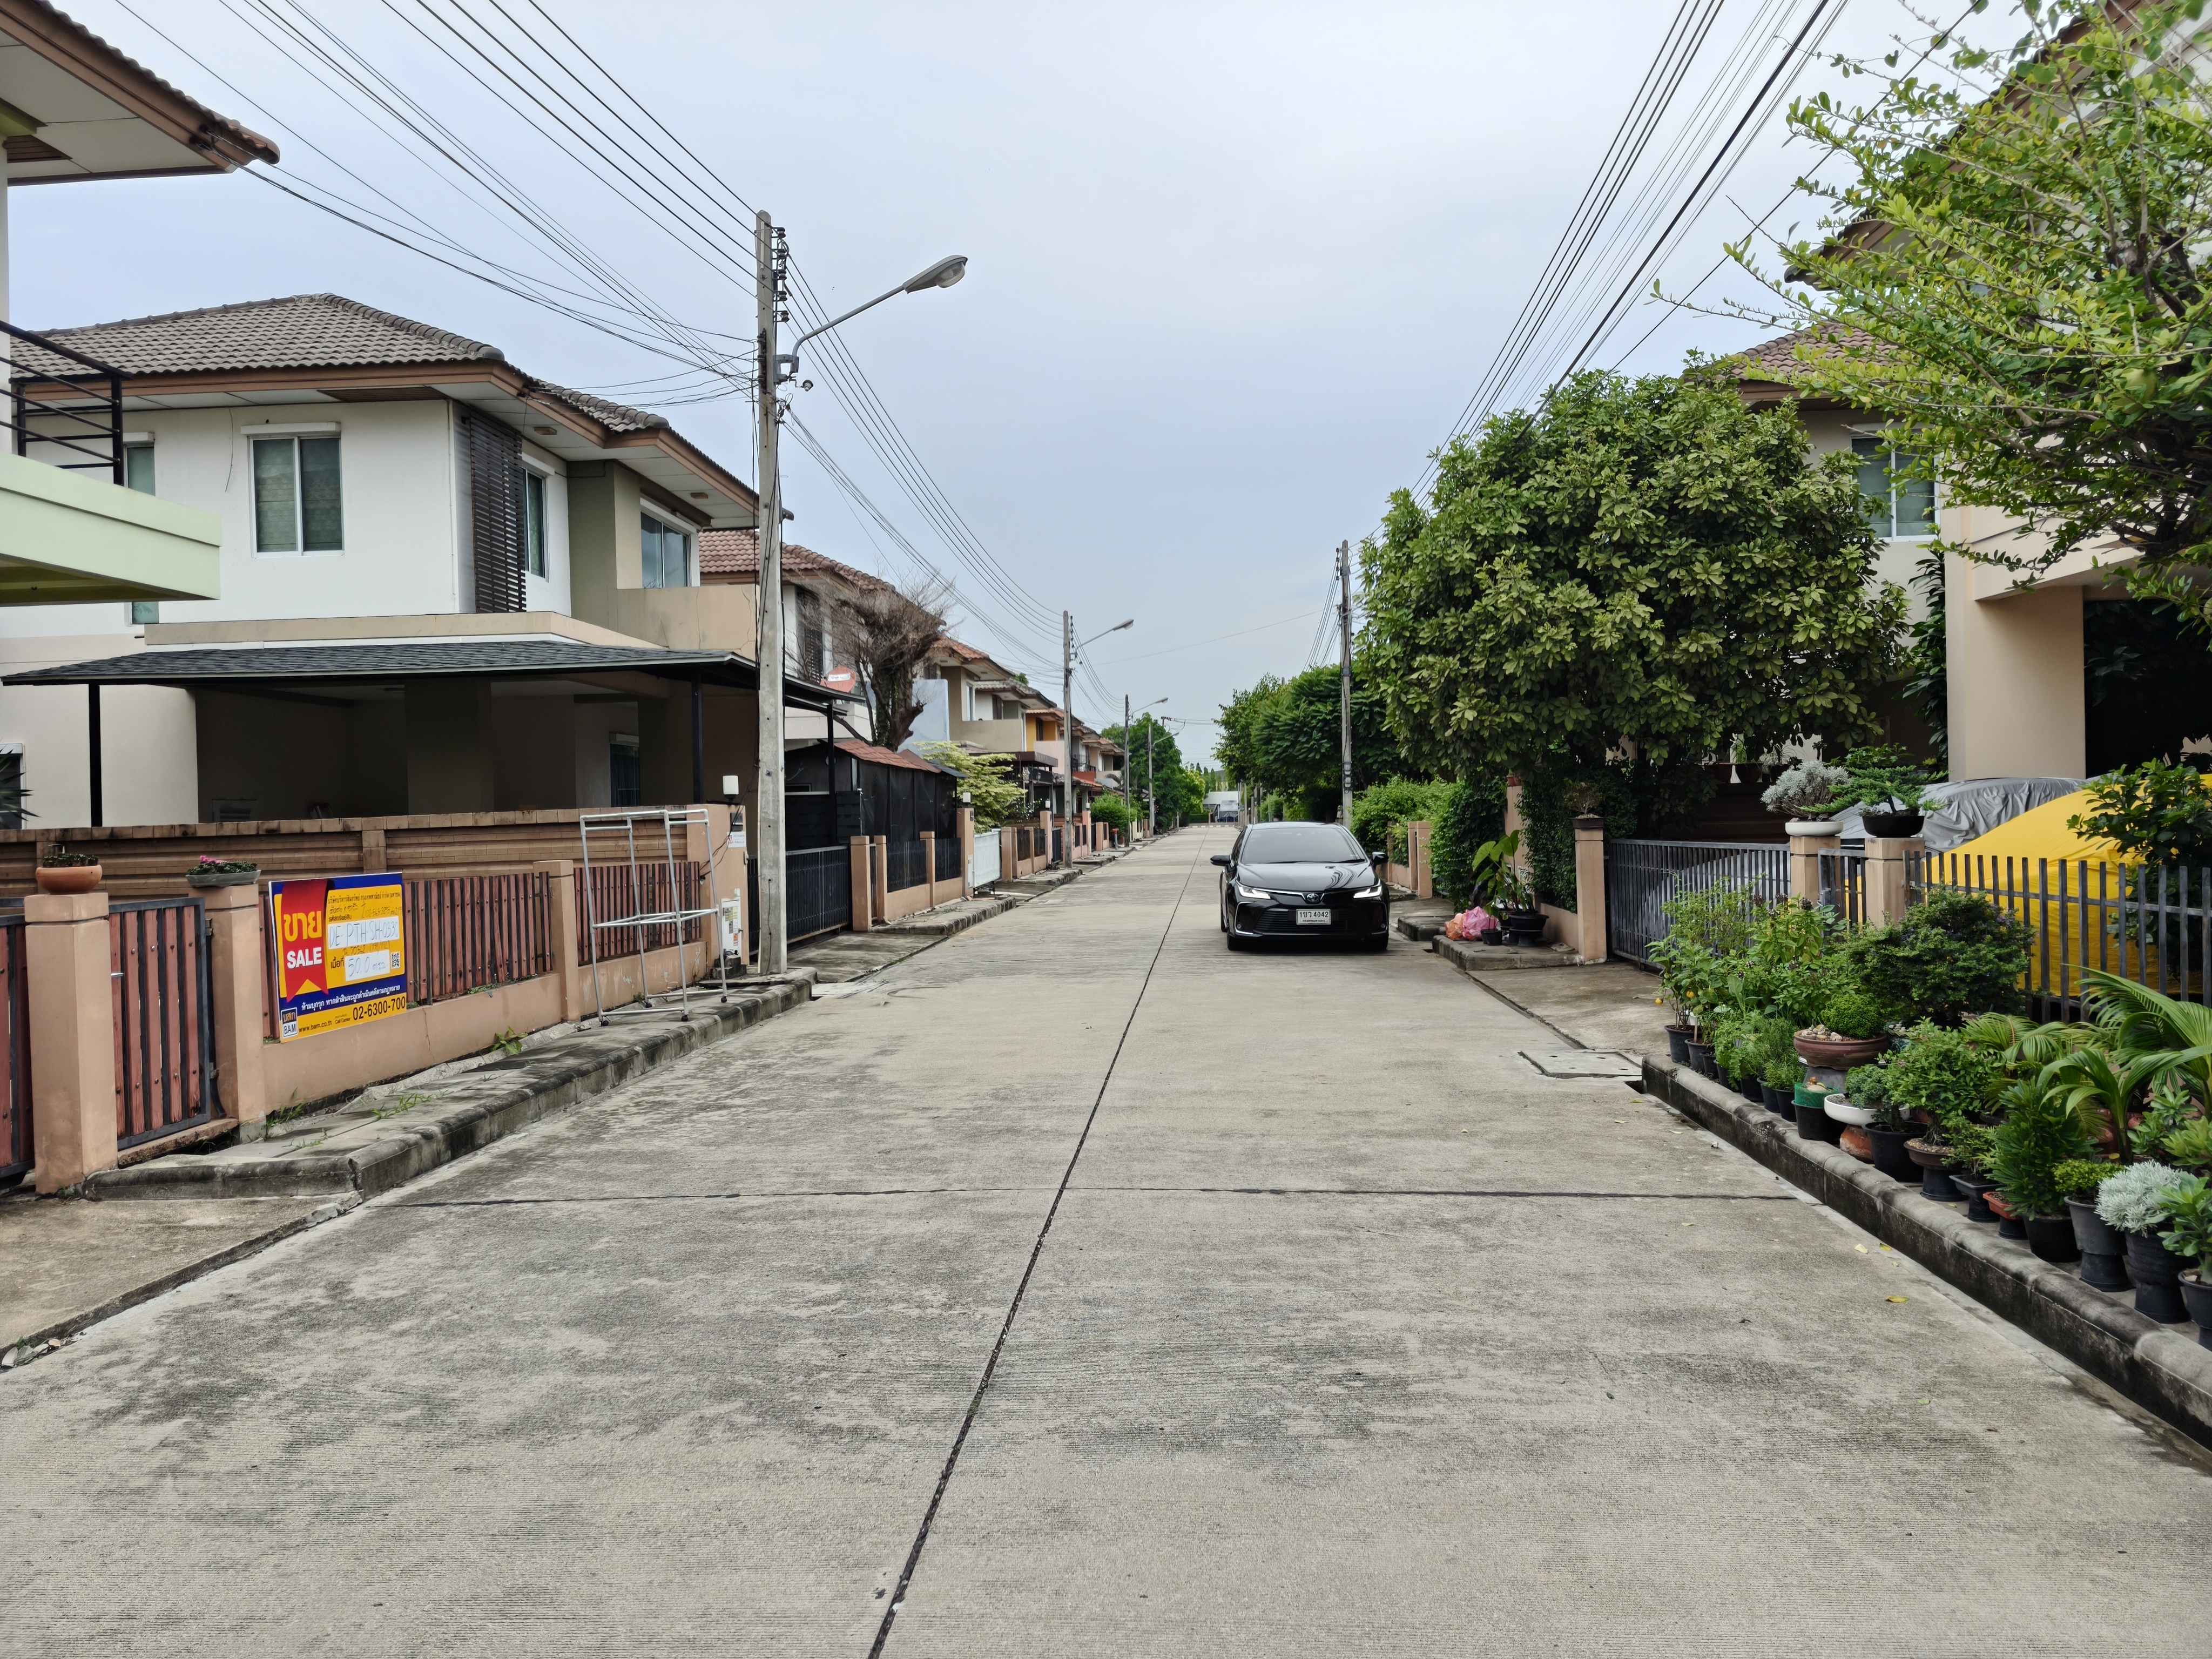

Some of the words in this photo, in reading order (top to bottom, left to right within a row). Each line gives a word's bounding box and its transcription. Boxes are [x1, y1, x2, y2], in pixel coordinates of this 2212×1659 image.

[284, 911, 322, 942] ขาย
[287, 947, 322, 969] SALE
[331, 956, 344, 968] เนื้อที่
[353, 996, 405, 1020] 02-6300-700
[284, 1024, 296, 1034] BAM
[299, 1020, 332, 1032] www.bam.co.th
